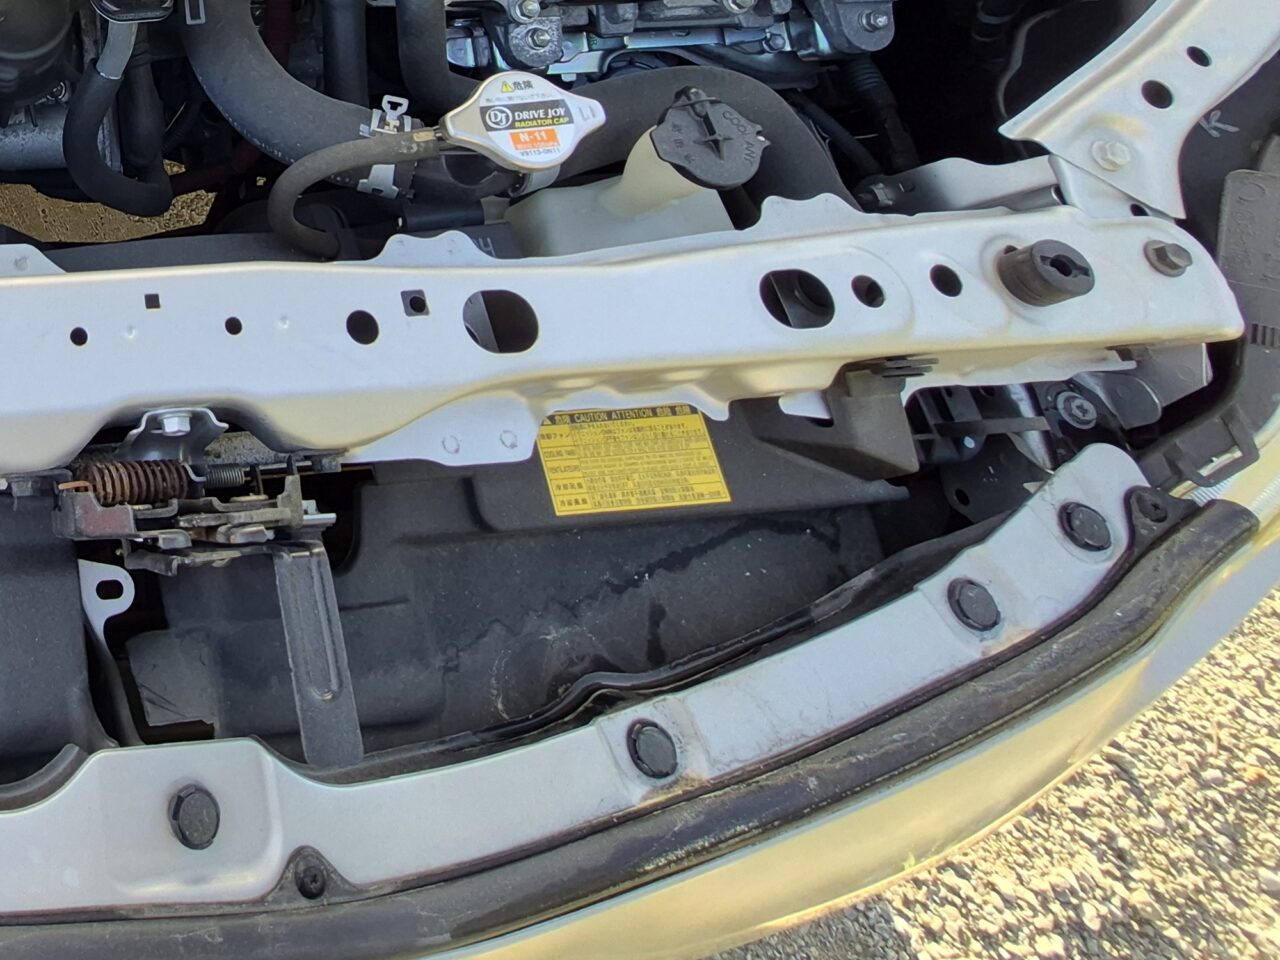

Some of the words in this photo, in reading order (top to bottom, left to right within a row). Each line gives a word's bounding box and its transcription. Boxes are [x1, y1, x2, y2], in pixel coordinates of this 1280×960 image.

[512, 80, 534, 91] 危険
[515, 109, 546, 121] DRIVE
[548, 107, 566, 119] JOY
[515, 119, 552, 128] RADIATOR
[520, 130, 548, 143] N-11
[575, 411, 608, 423] CAUTION
[611, 408, 653, 420] ATTENTION
